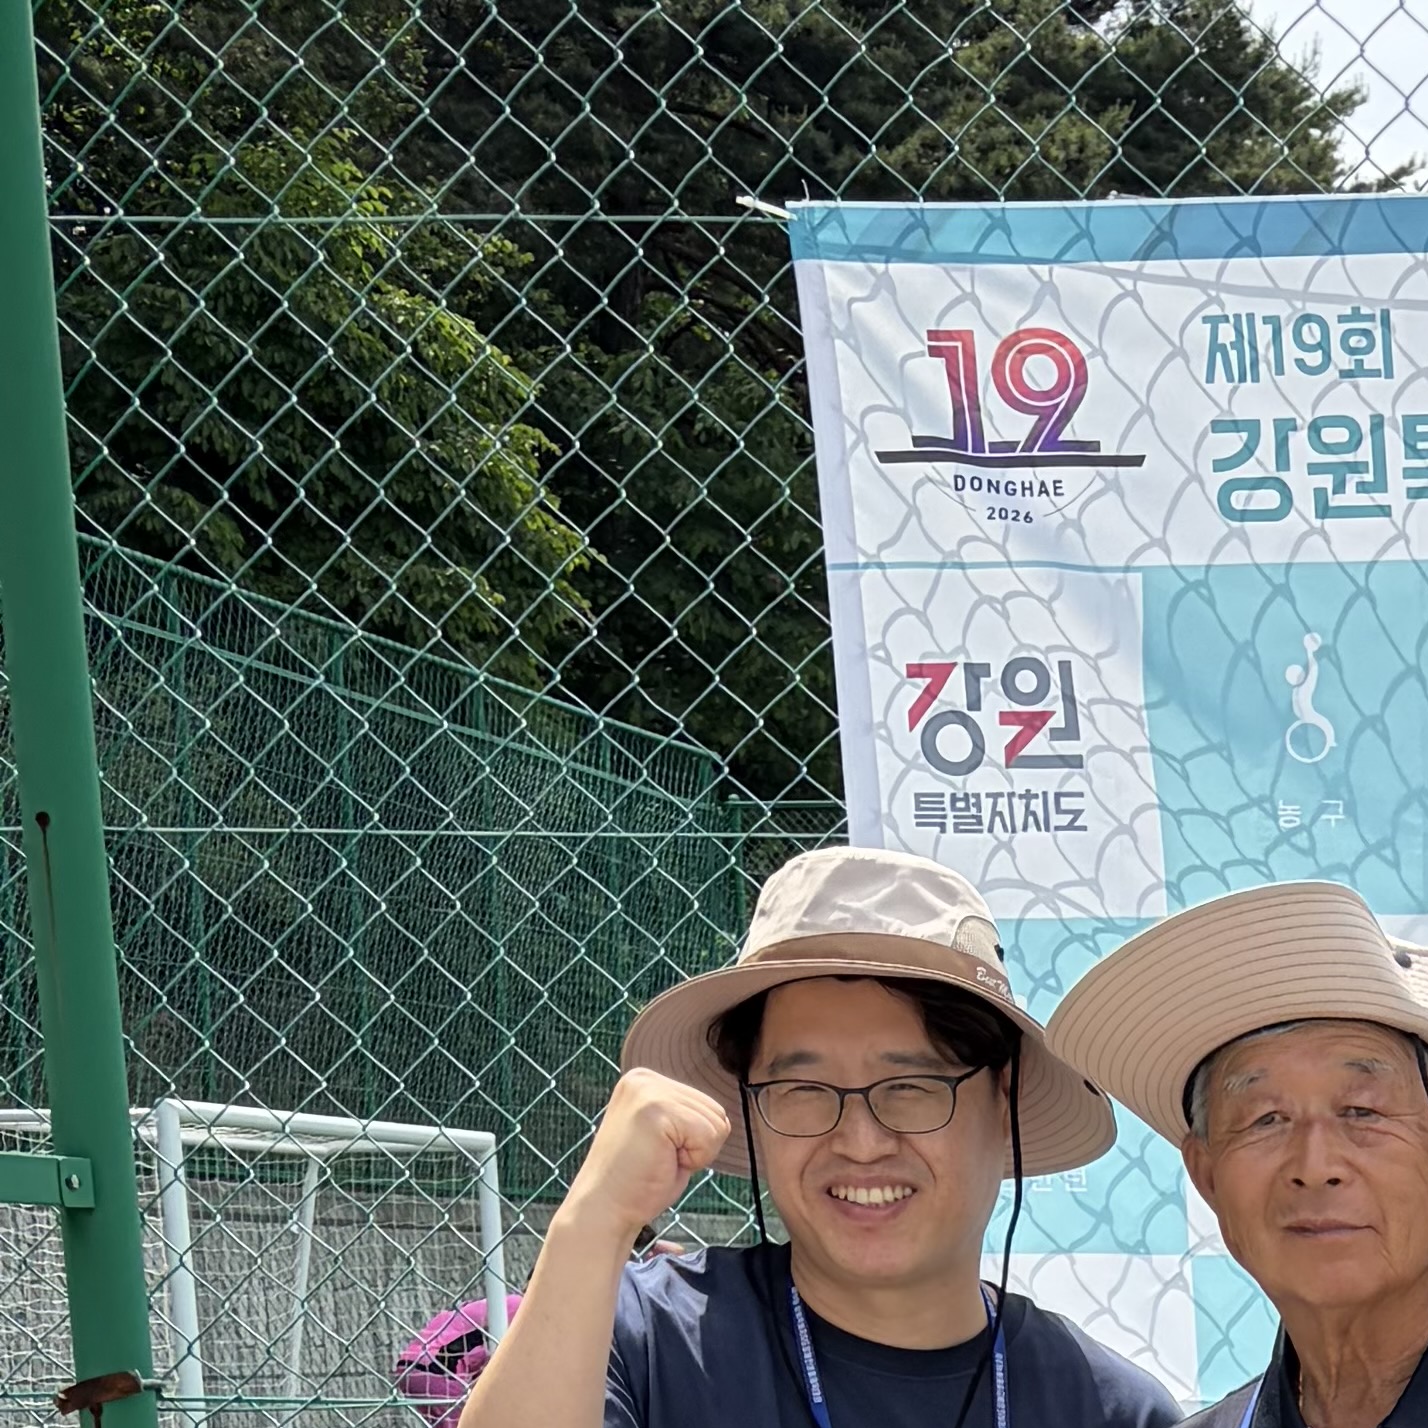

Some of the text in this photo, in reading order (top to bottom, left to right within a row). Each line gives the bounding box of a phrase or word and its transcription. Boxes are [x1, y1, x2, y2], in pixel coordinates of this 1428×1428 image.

[1203, 306, 1395, 385] 제19회
[912, 327, 1100, 454] 19
[953, 473, 1066, 498] DONGHAE
[986, 506, 1034, 524] 2026
[905, 656, 1084, 777] 강원
[914, 789, 1088, 834] 특별자치도
